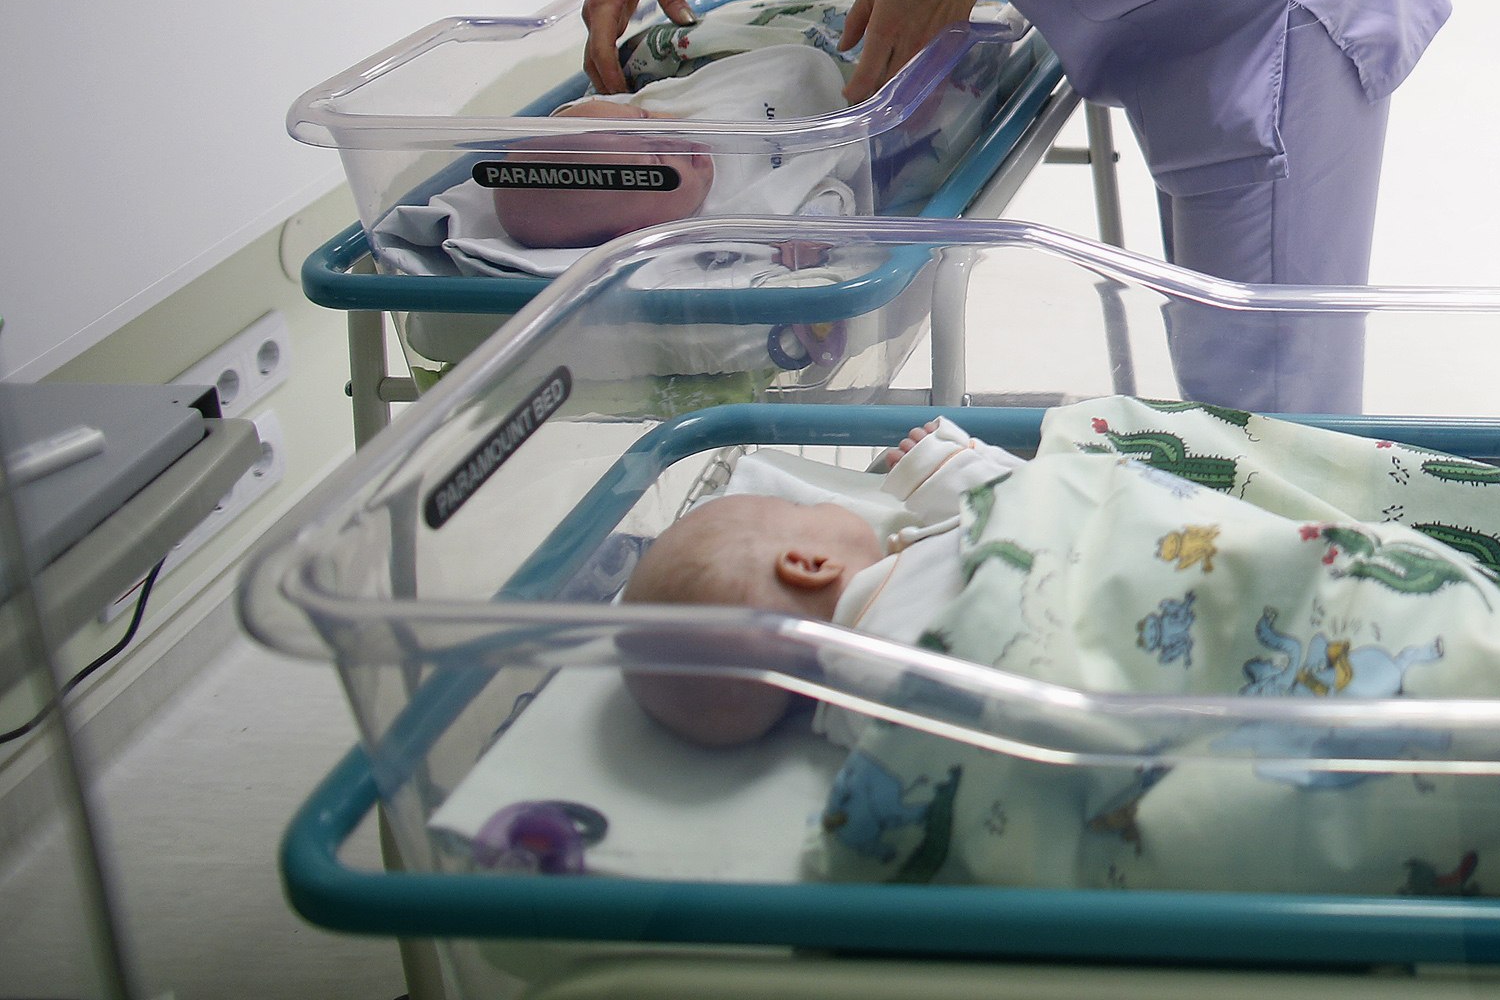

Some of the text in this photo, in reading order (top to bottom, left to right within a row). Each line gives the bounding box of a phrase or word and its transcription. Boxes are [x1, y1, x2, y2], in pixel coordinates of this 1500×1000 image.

[486, 167, 664, 187] PARAMOUNT BED
[435, 378, 564, 518] PARAMOUNT BED
